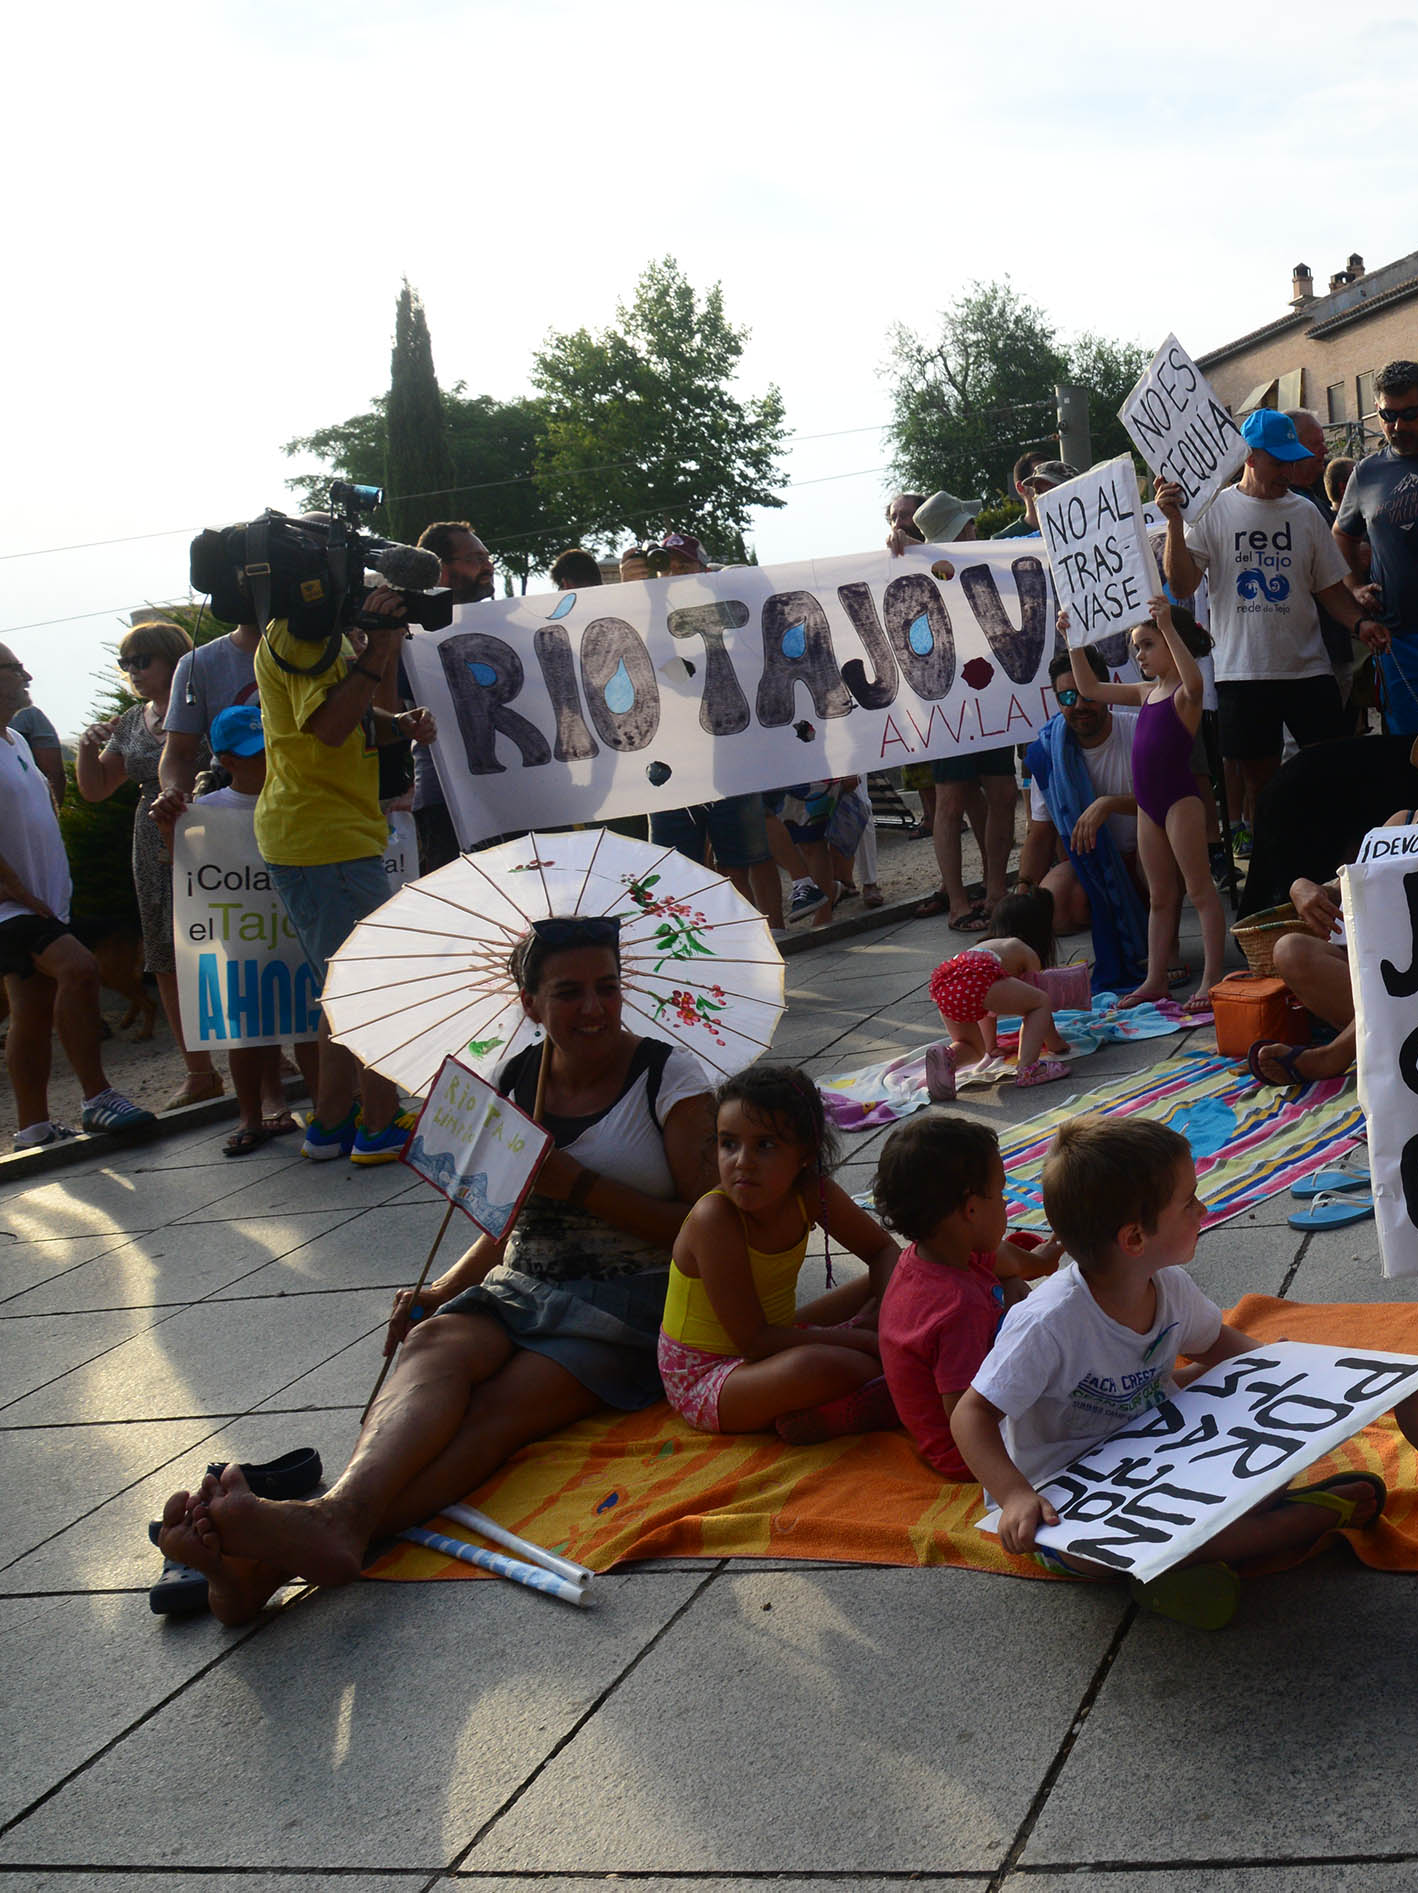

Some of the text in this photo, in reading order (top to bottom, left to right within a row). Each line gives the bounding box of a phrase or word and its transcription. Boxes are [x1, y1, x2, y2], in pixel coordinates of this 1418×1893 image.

[1131, 348, 1197, 453] NO ES
[1160, 398, 1242, 509] SEQUÍA
[1046, 480, 1134, 552] NO AL
[1235, 521, 1292, 551] red
[1058, 536, 1131, 594] TRAS-
[1235, 551, 1292, 572] del Tajo
[1072, 576, 1141, 632] VASE
[438, 593, 662, 775] RÍO
[667, 573, 957, 736] TAJO
[189, 918, 214, 942] el
[1064, 1372, 1309, 1521] TAJO
[1067, 1483, 1227, 1568] UN
